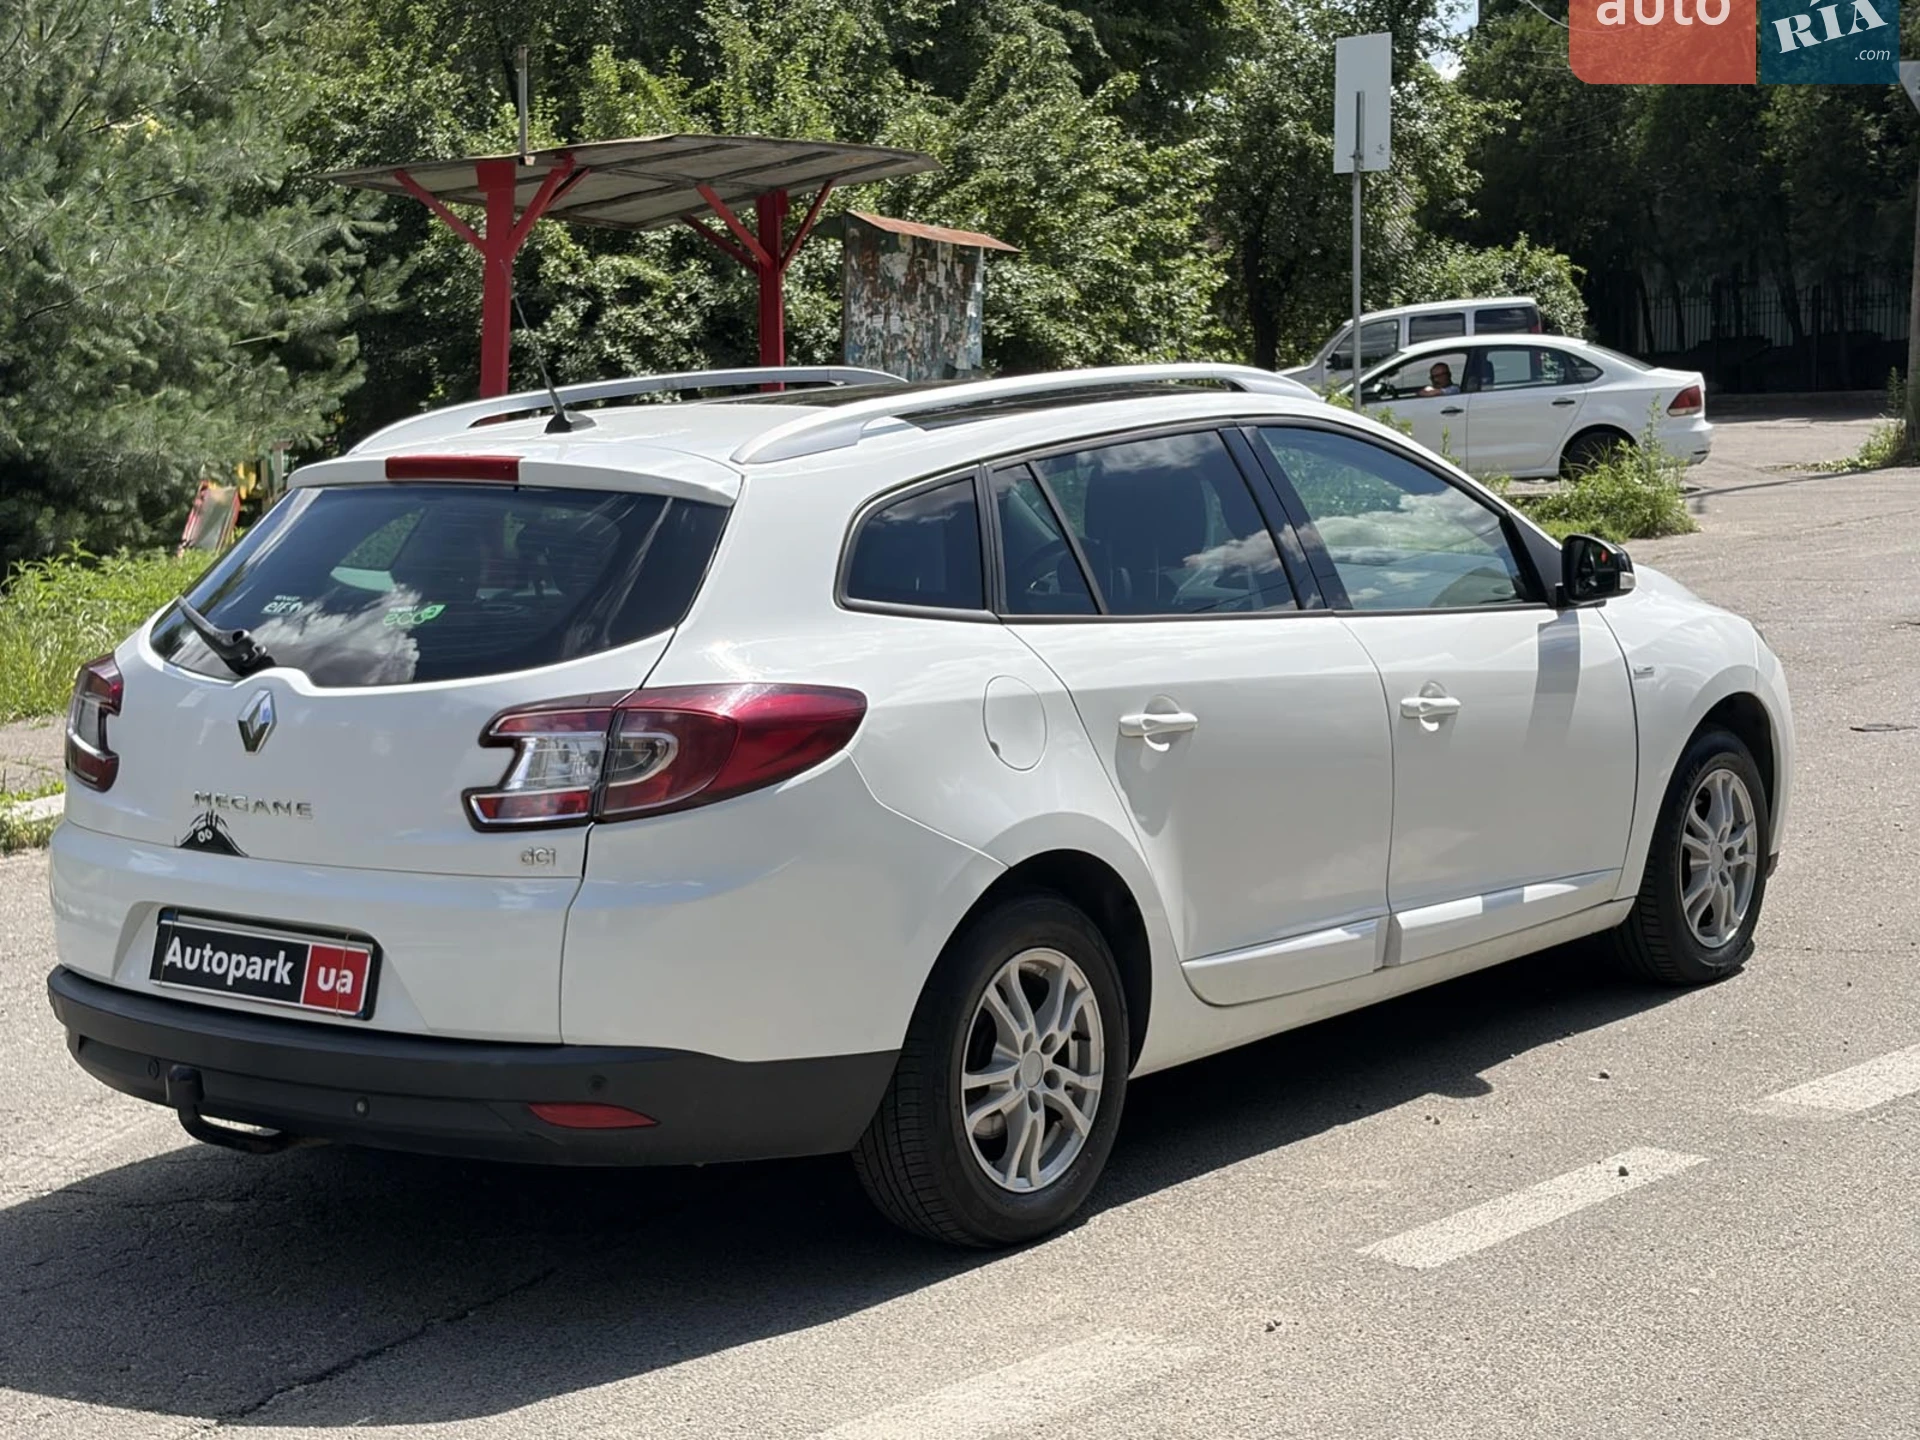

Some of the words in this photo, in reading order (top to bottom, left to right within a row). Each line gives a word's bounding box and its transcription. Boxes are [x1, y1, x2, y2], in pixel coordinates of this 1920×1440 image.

[193, 790, 313, 820] MEGANE
[163, 936, 294, 985] Autopark
[317, 966, 354, 994] ua
